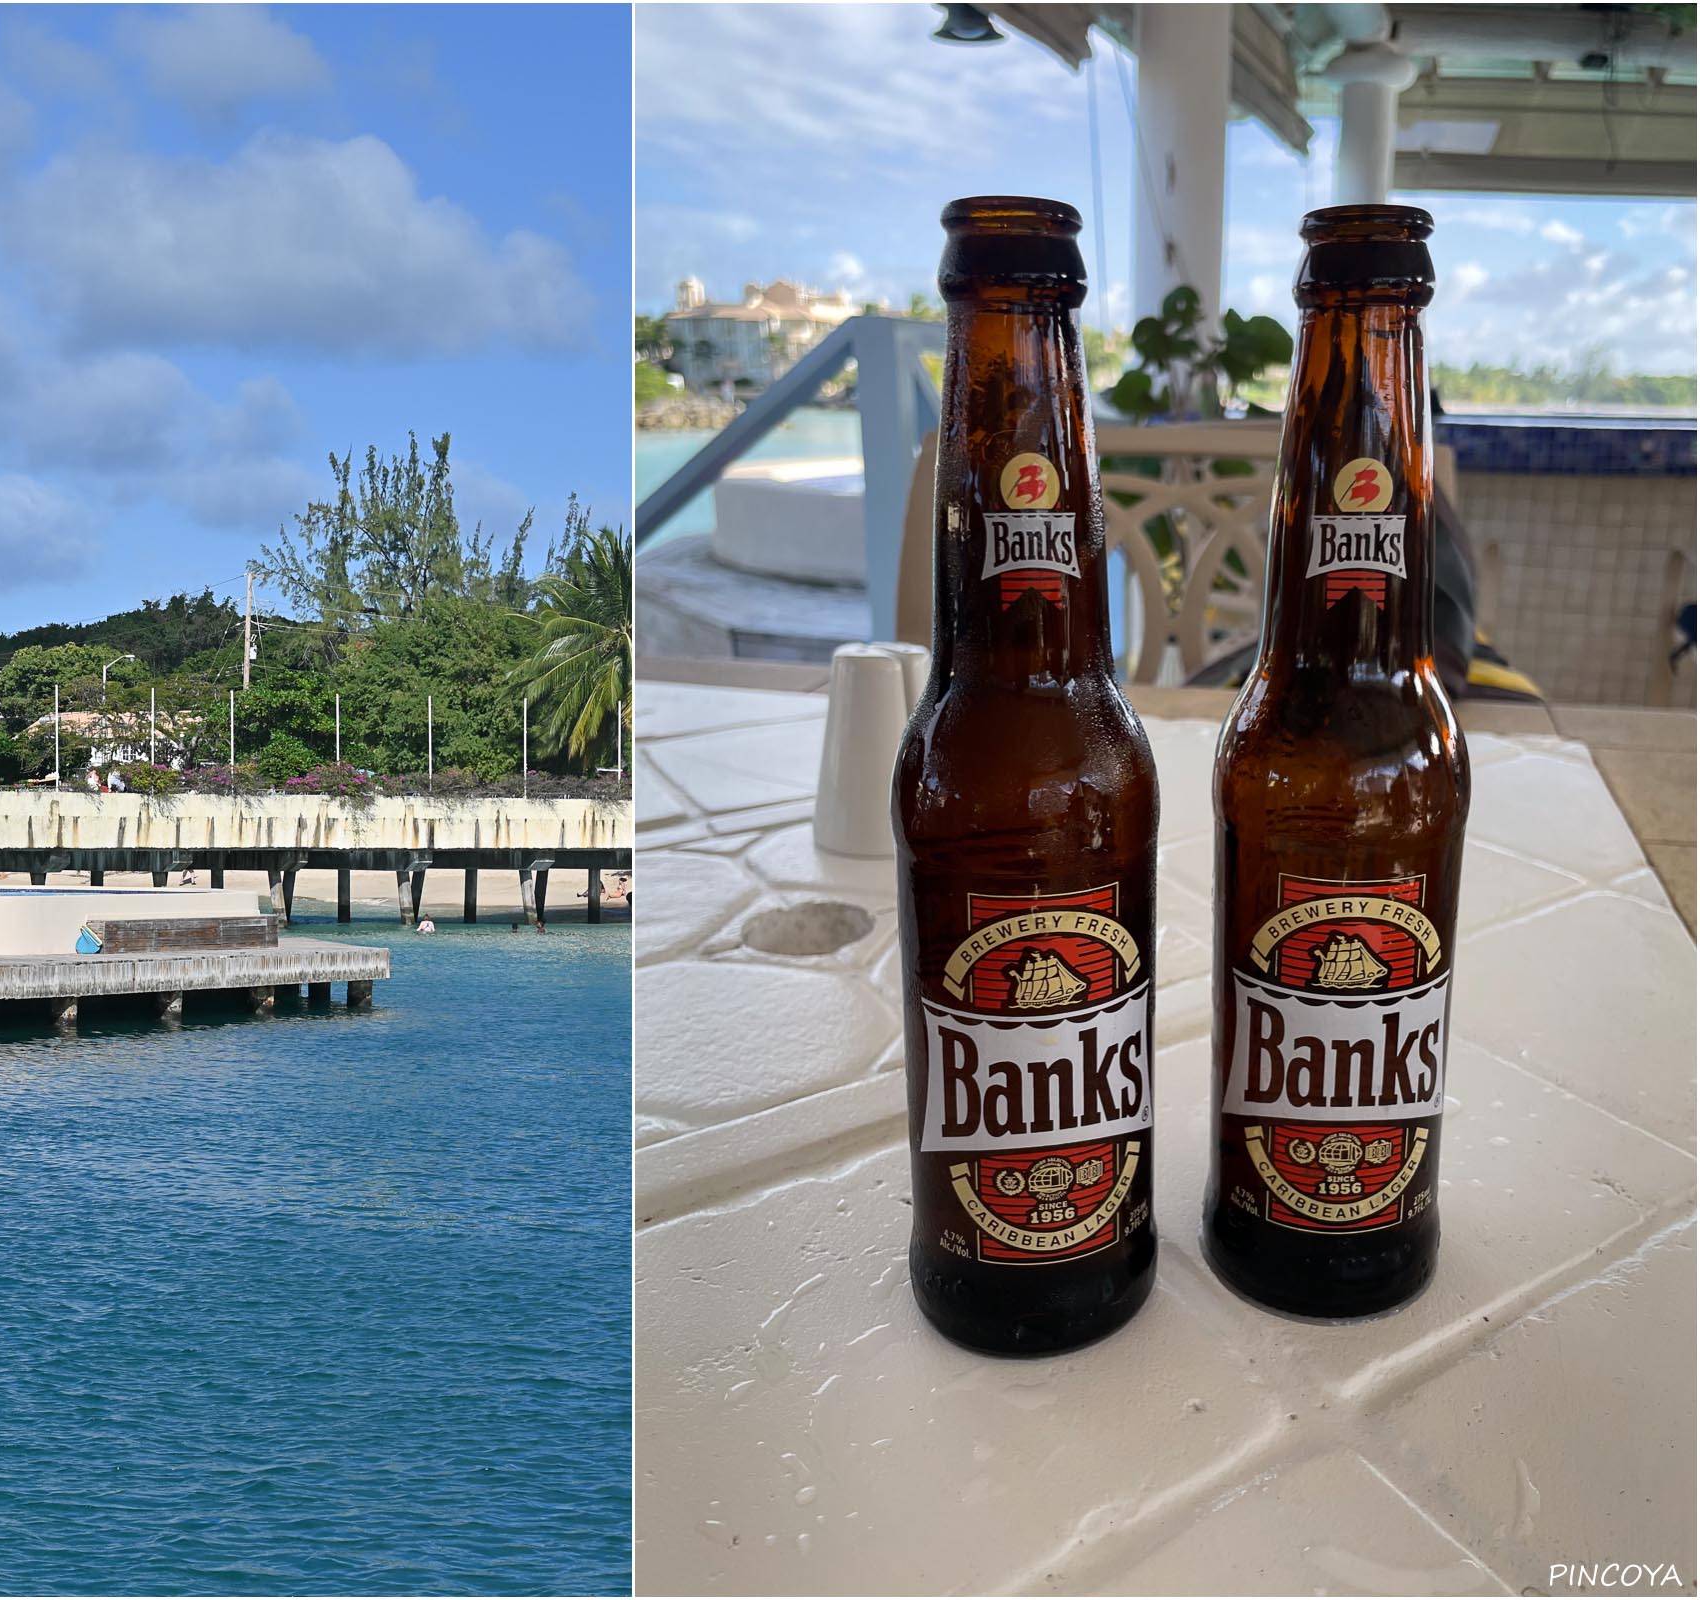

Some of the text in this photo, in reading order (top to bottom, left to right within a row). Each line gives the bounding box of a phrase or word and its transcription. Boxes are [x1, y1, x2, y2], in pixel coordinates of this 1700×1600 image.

[992, 521, 1073, 568] Banks
[1318, 523, 1401, 568] Banks
[959, 915, 1128, 964] BREWERY FRESH
[1268, 901, 1432, 941] BREWERY FRESH
[1244, 995, 1440, 1108] Banks
[938, 1026, 1143, 1138] Banks
[1258, 1159, 1417, 1219] CARIBBEAN LAGER
[1318, 1182, 1362, 1195] 1956
[1327, 1175, 1356, 1183] SINCE
[967, 1175, 1130, 1248] CARIBBEAN LAGER
[1030, 1207, 1076, 1224] 1956
[1038, 1200, 1068, 1211] SINCE
[943, 1229, 966, 1246] 4.7%
